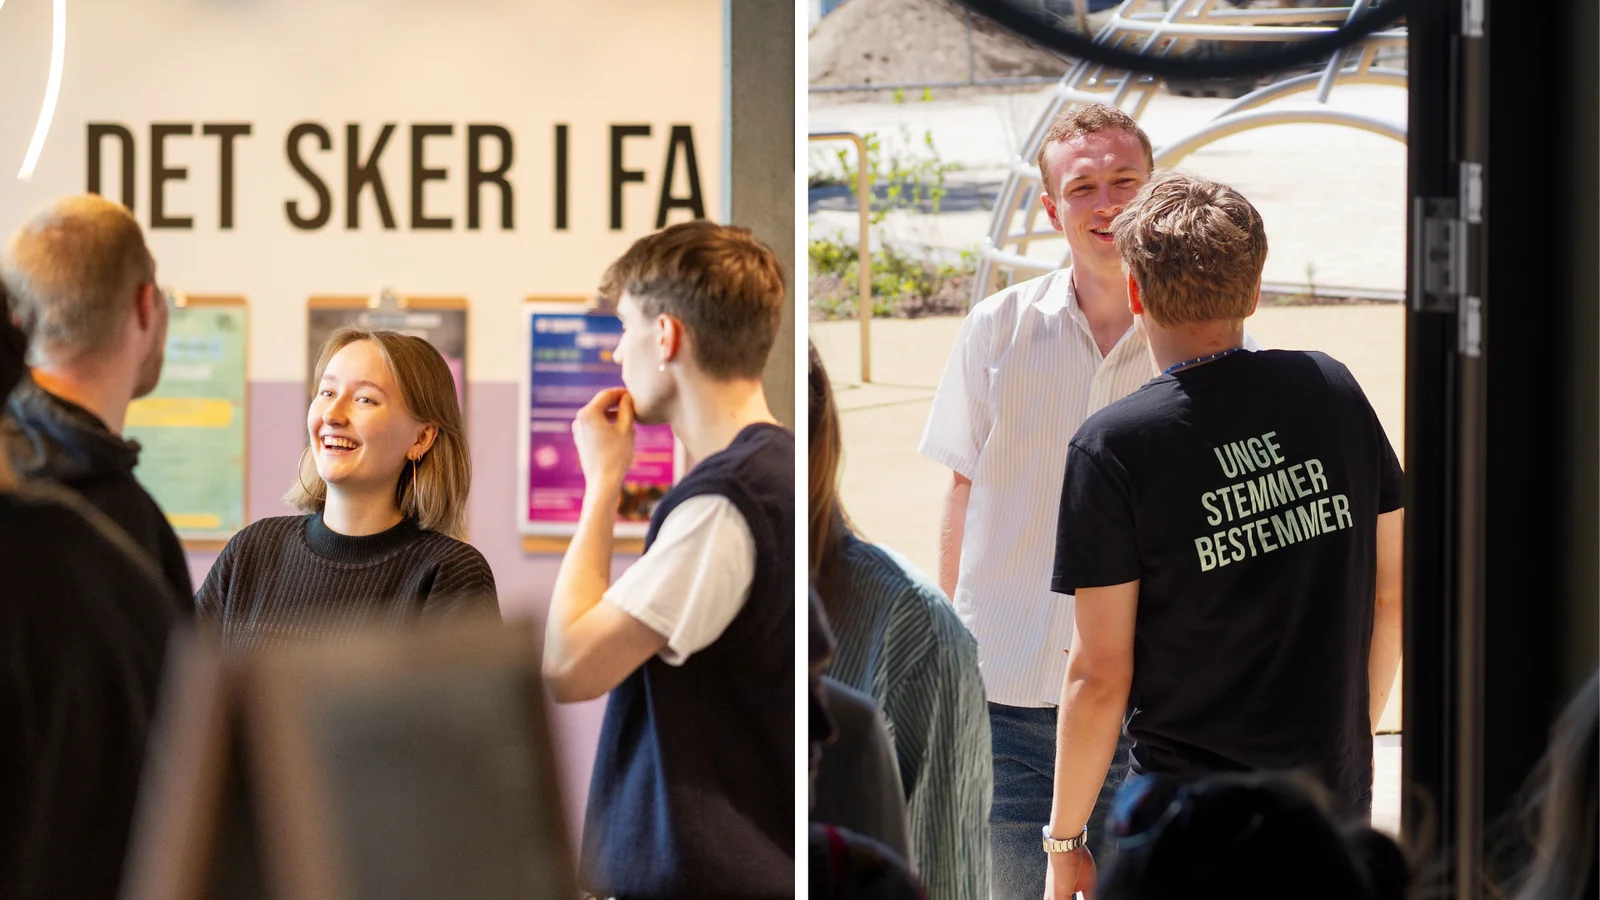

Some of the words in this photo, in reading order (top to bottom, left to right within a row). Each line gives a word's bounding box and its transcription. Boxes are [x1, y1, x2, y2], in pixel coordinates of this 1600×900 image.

[86, 122, 252, 230] DET
[284, 122, 515, 230] SKER
[553, 123, 570, 230] I
[608, 123, 706, 229] FA
[1213, 430, 1285, 478] UNGE
[1201, 458, 1328, 526] STEMMER
[1194, 494, 1353, 572] BESTEMMER
